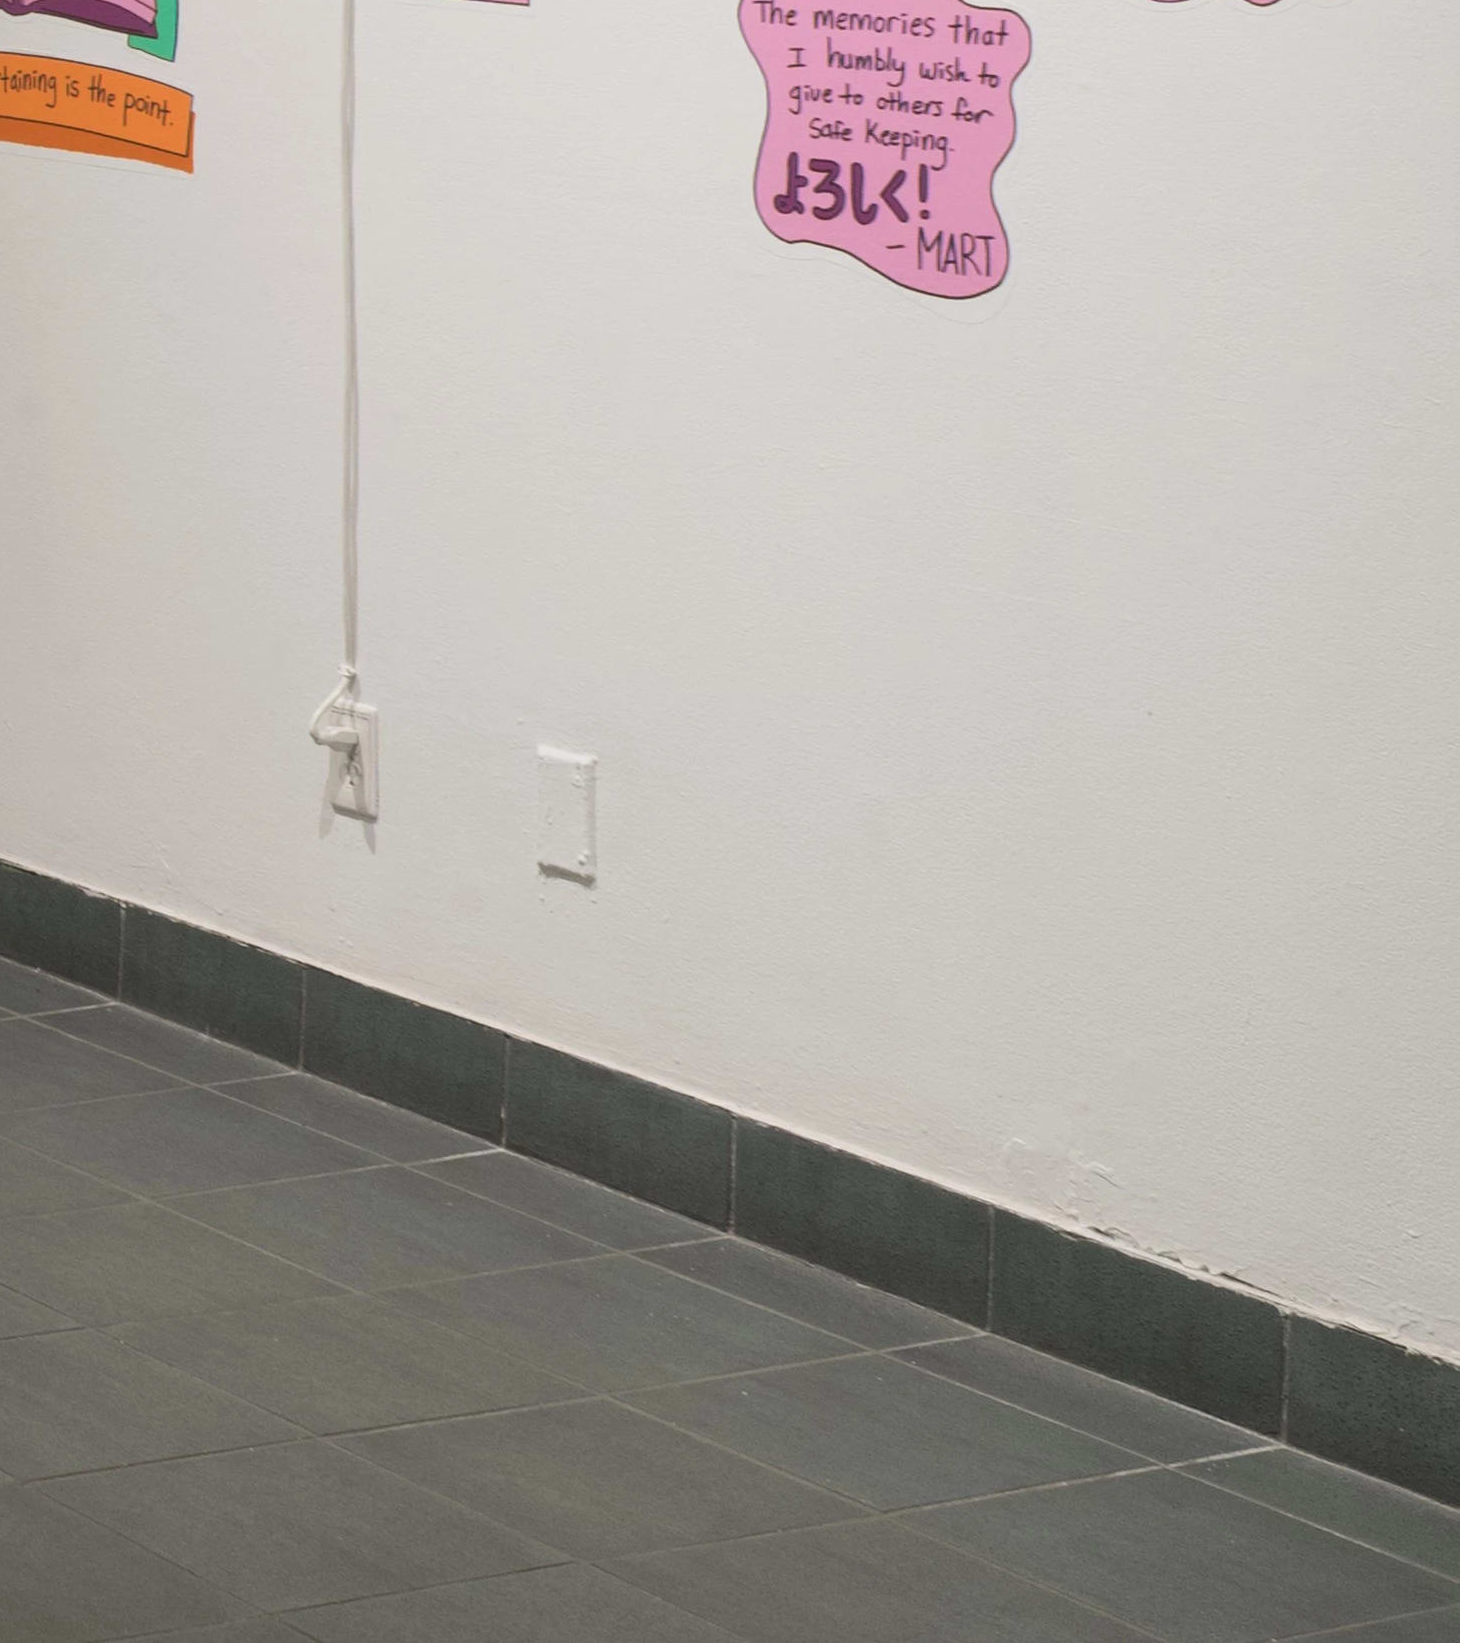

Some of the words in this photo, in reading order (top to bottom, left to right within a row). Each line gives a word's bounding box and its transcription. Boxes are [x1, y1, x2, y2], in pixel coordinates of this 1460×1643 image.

[813, 9, 936, 37] memories
[948, 15, 1009, 46] that
[827, 37, 906, 87] humbly
[919, 58, 970, 82] wish
[978, 62, 999, 88] to
[87, 75, 115, 107] the
[123, 88, 174, 127] point.
[788, 85, 833, 114] give
[837, 84, 864, 105] to
[877, 93, 944, 116] others
[951, 97, 994, 124] for
